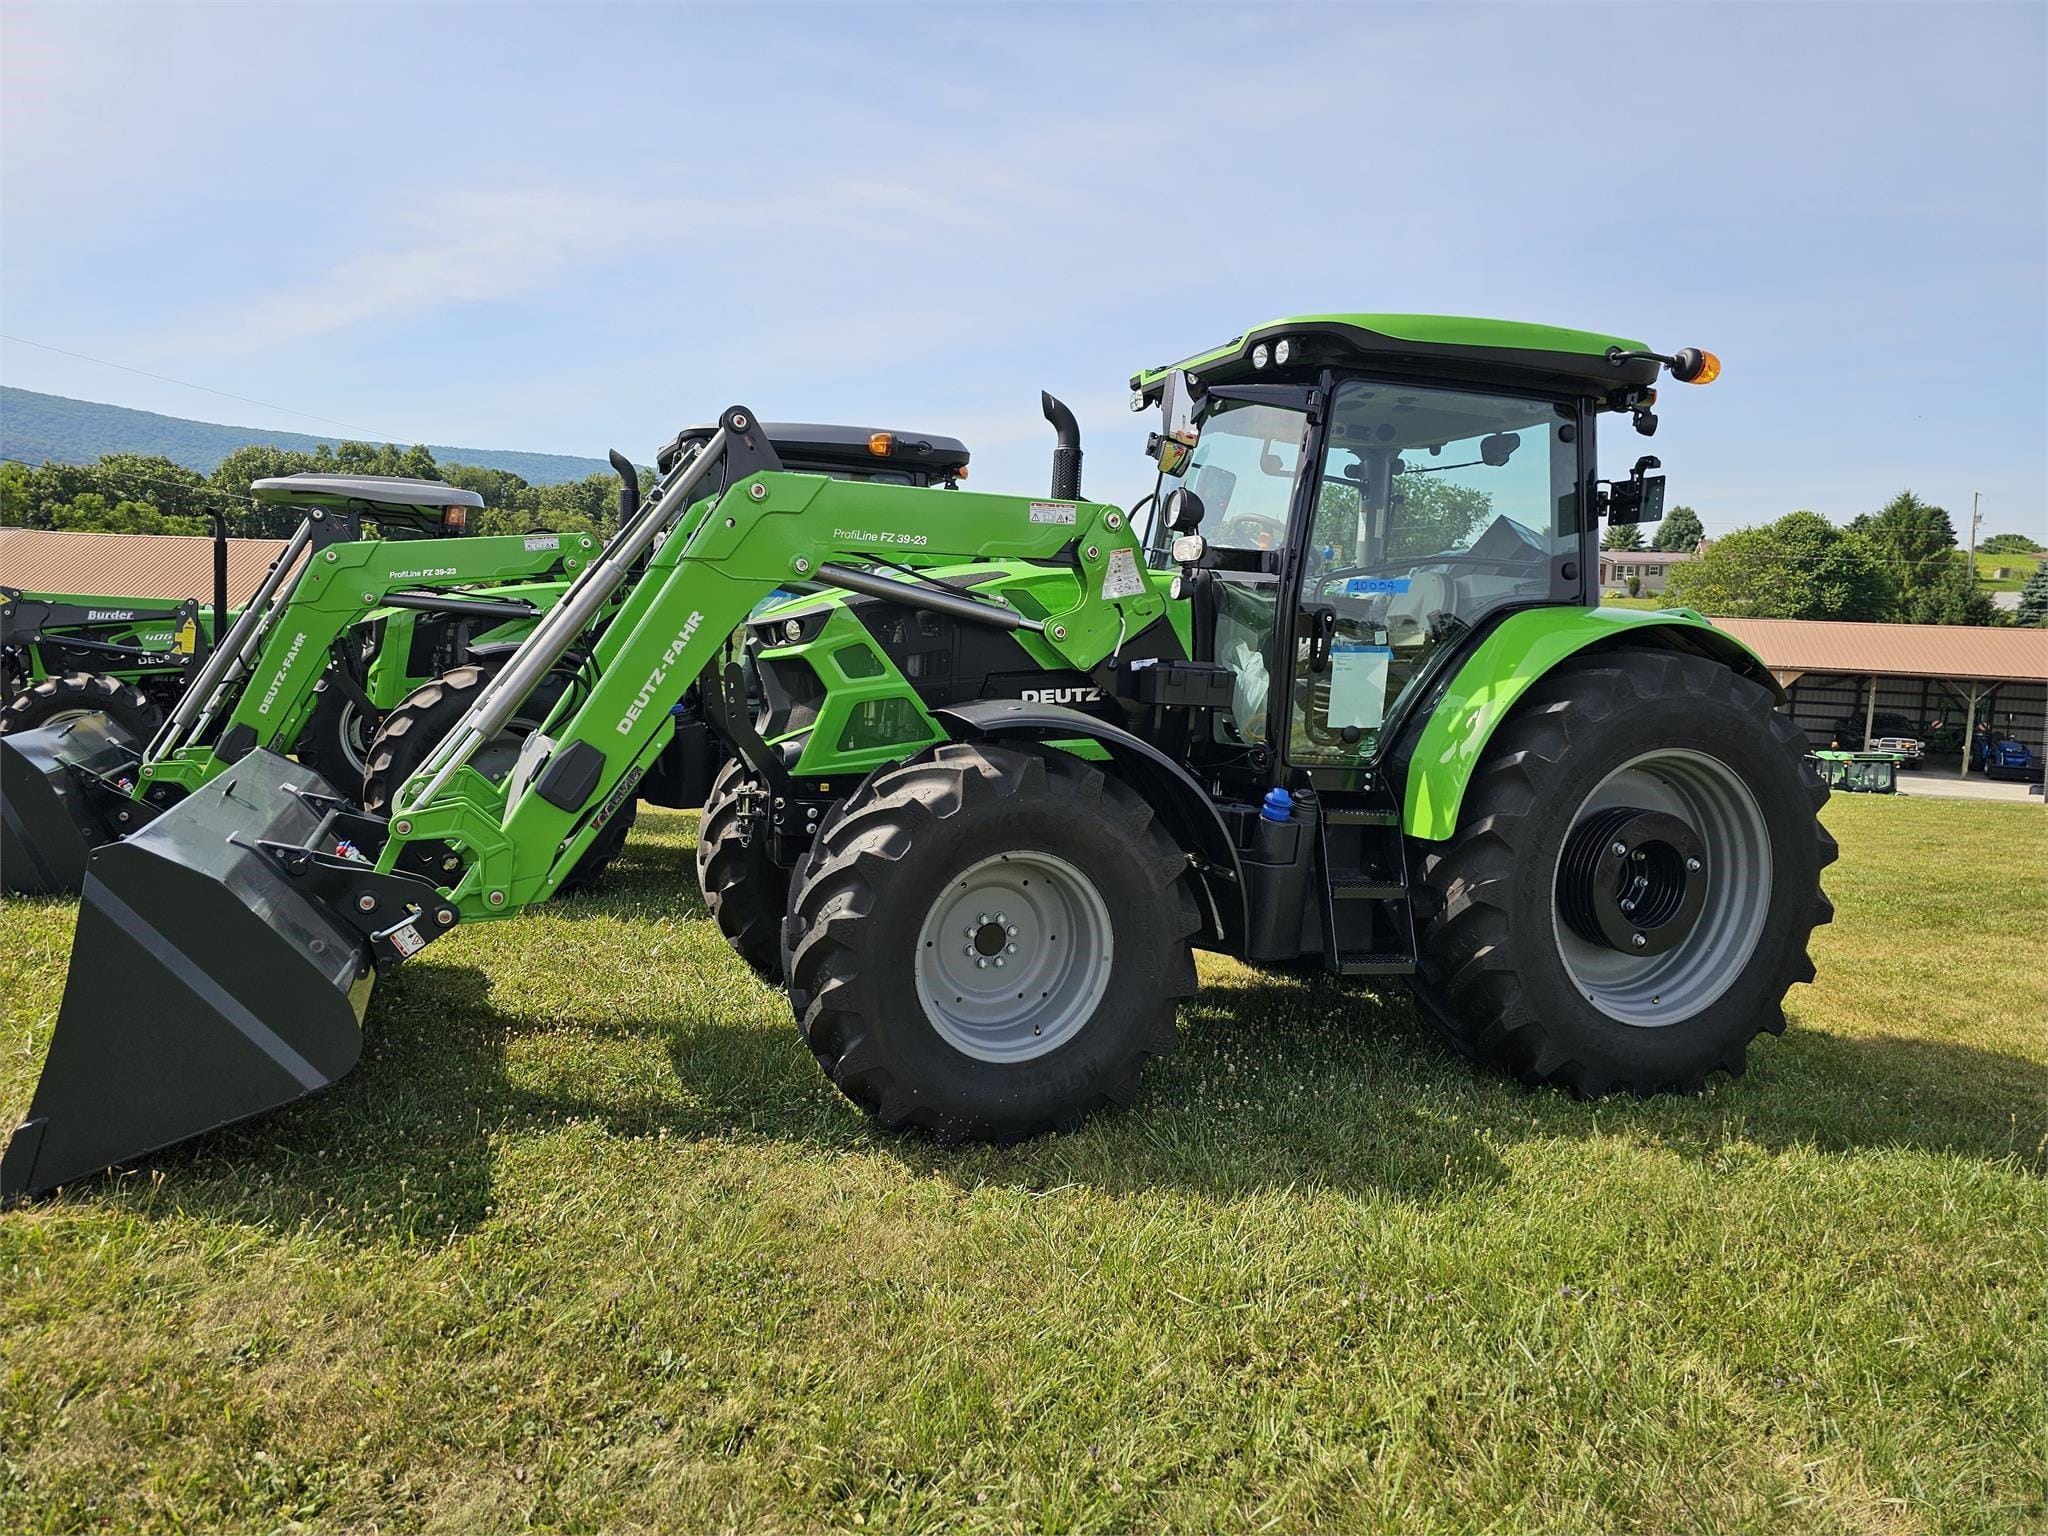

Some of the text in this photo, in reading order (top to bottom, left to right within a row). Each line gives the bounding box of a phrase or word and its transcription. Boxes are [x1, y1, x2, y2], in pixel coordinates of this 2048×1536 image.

[833, 528, 927, 545] ProfiLine FZ 39-23
[390, 567, 457, 578] ProfiLine FZ 39-23
[88, 610, 134, 620] Burder
[259, 632, 307, 714] DEUTZ-FAHR
[616, 610, 704, 735] DEUTZ-FAHR
